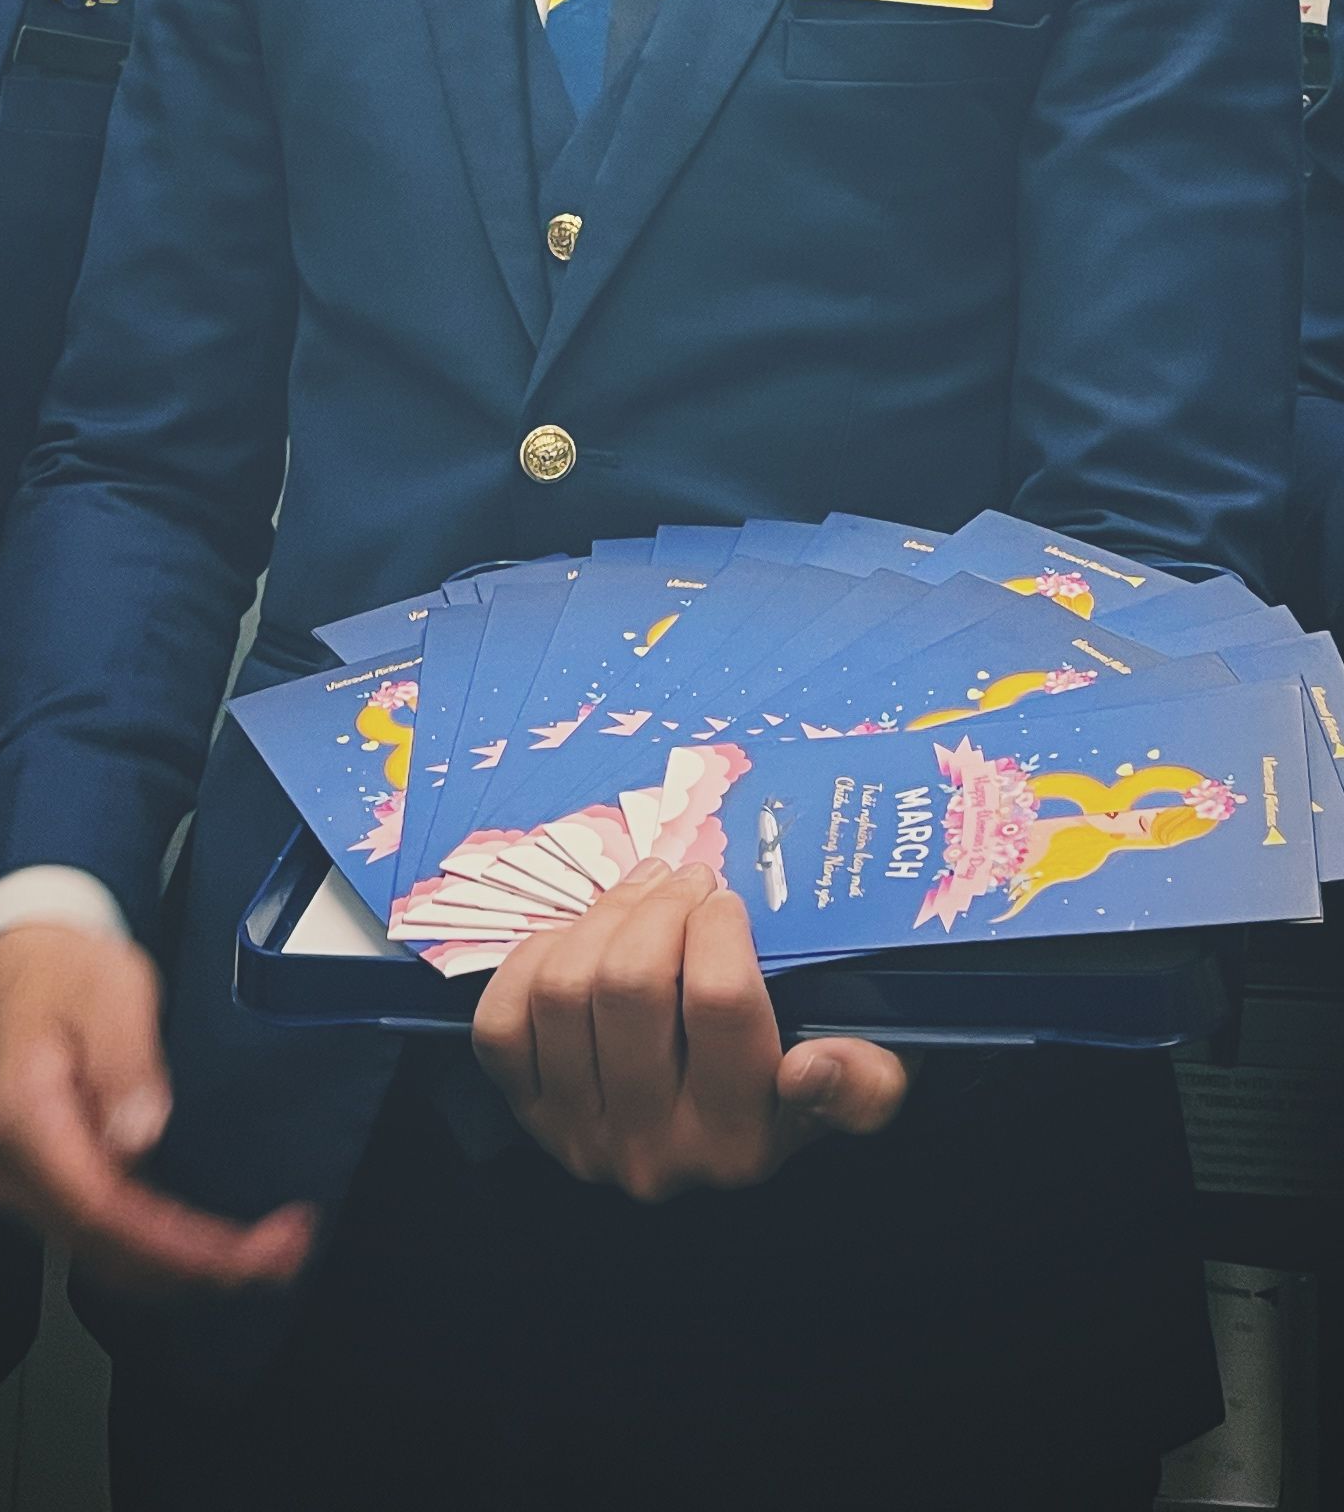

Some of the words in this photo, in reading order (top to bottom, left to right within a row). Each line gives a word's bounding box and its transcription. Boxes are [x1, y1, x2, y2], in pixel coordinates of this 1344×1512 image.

[967, 775, 991, 808] Happy
[884, 786, 934, 879] MARCH
[847, 852, 874, 874] bay
[957, 855, 985, 880] Day
